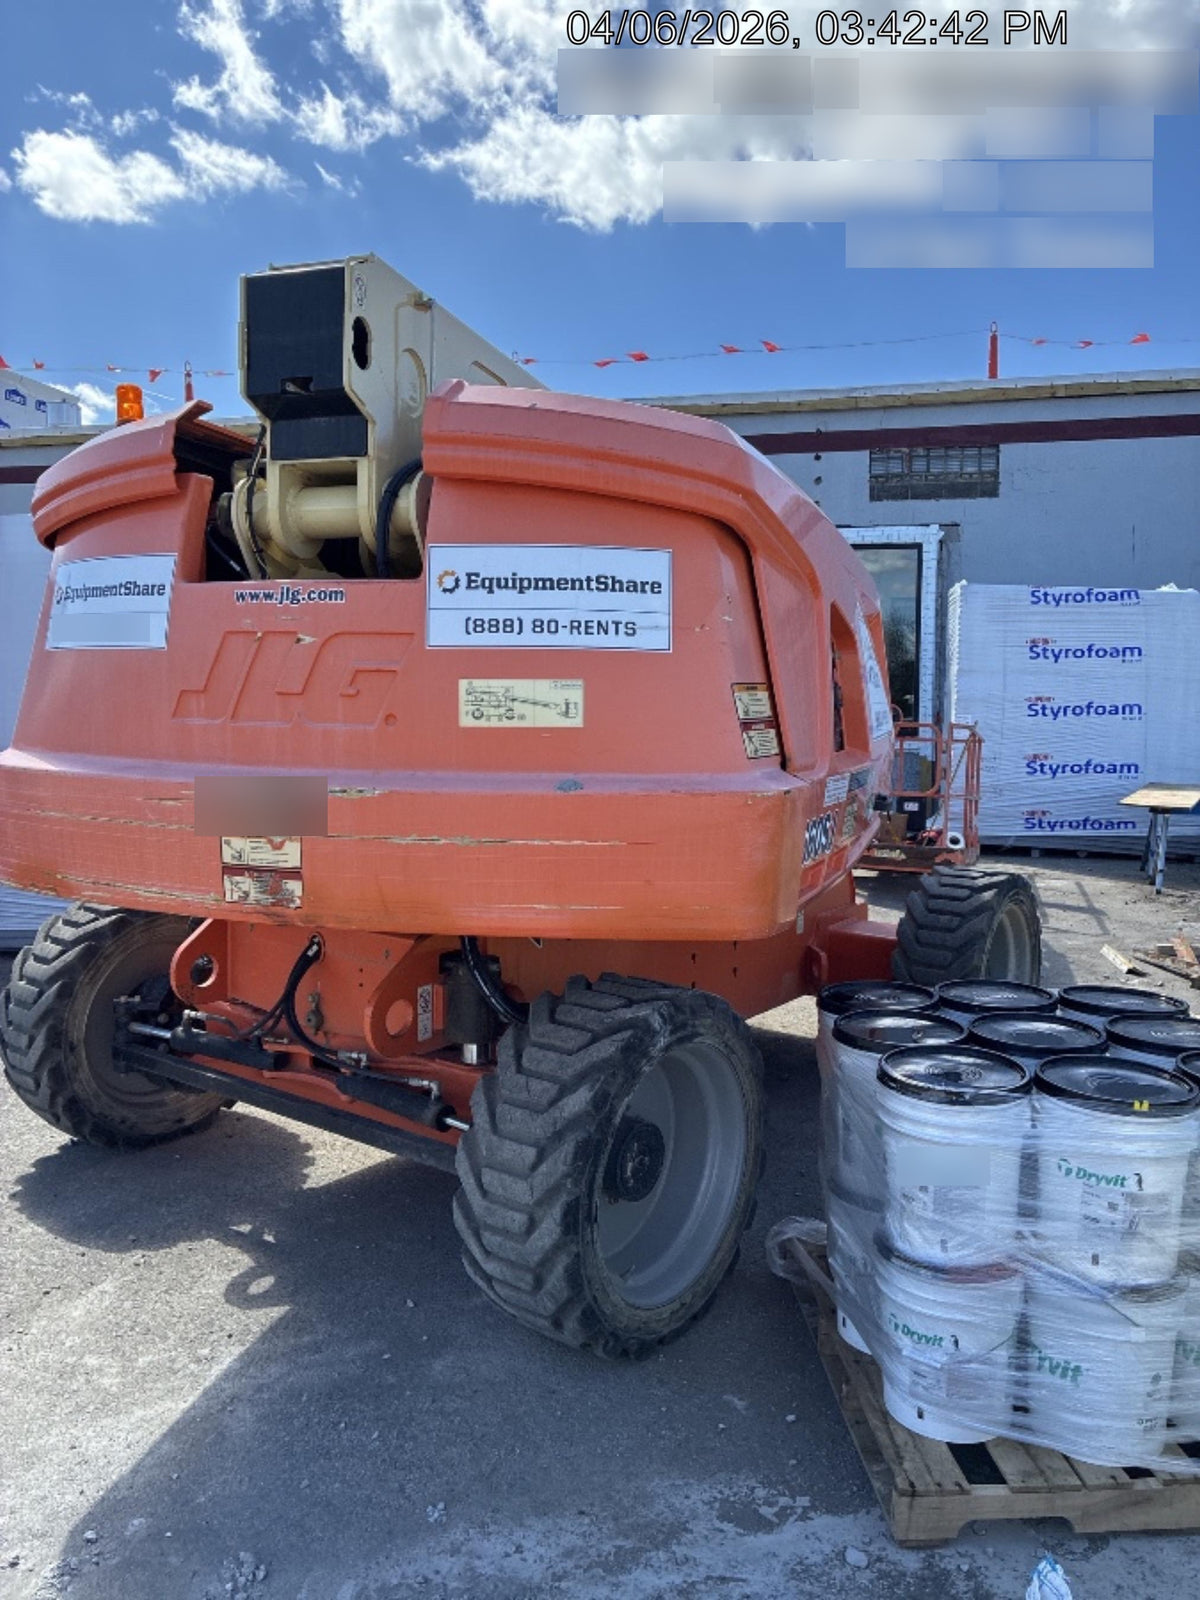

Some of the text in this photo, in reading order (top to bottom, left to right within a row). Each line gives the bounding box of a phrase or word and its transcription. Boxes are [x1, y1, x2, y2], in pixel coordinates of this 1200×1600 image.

[64, 581, 166, 604] EquipmentShare
[465, 572, 662, 594] EquipmentShare
[235, 586, 344, 604] www.jlg.com
[1030, 588, 1140, 607] Styrofoam
[465, 616, 637, 636] (888) 80-RENTS
[1029, 644, 1142, 663] Styrofoam
[171, 630, 415, 729] JLG
[1027, 701, 1142, 720] Styrofoam
[1025, 758, 1139, 779] Styrofoam
[1023, 816, 1137, 832] Styrofoam
[1075, 1166, 1127, 1187] Dryvit
[901, 1324, 943, 1348] Dryvit
